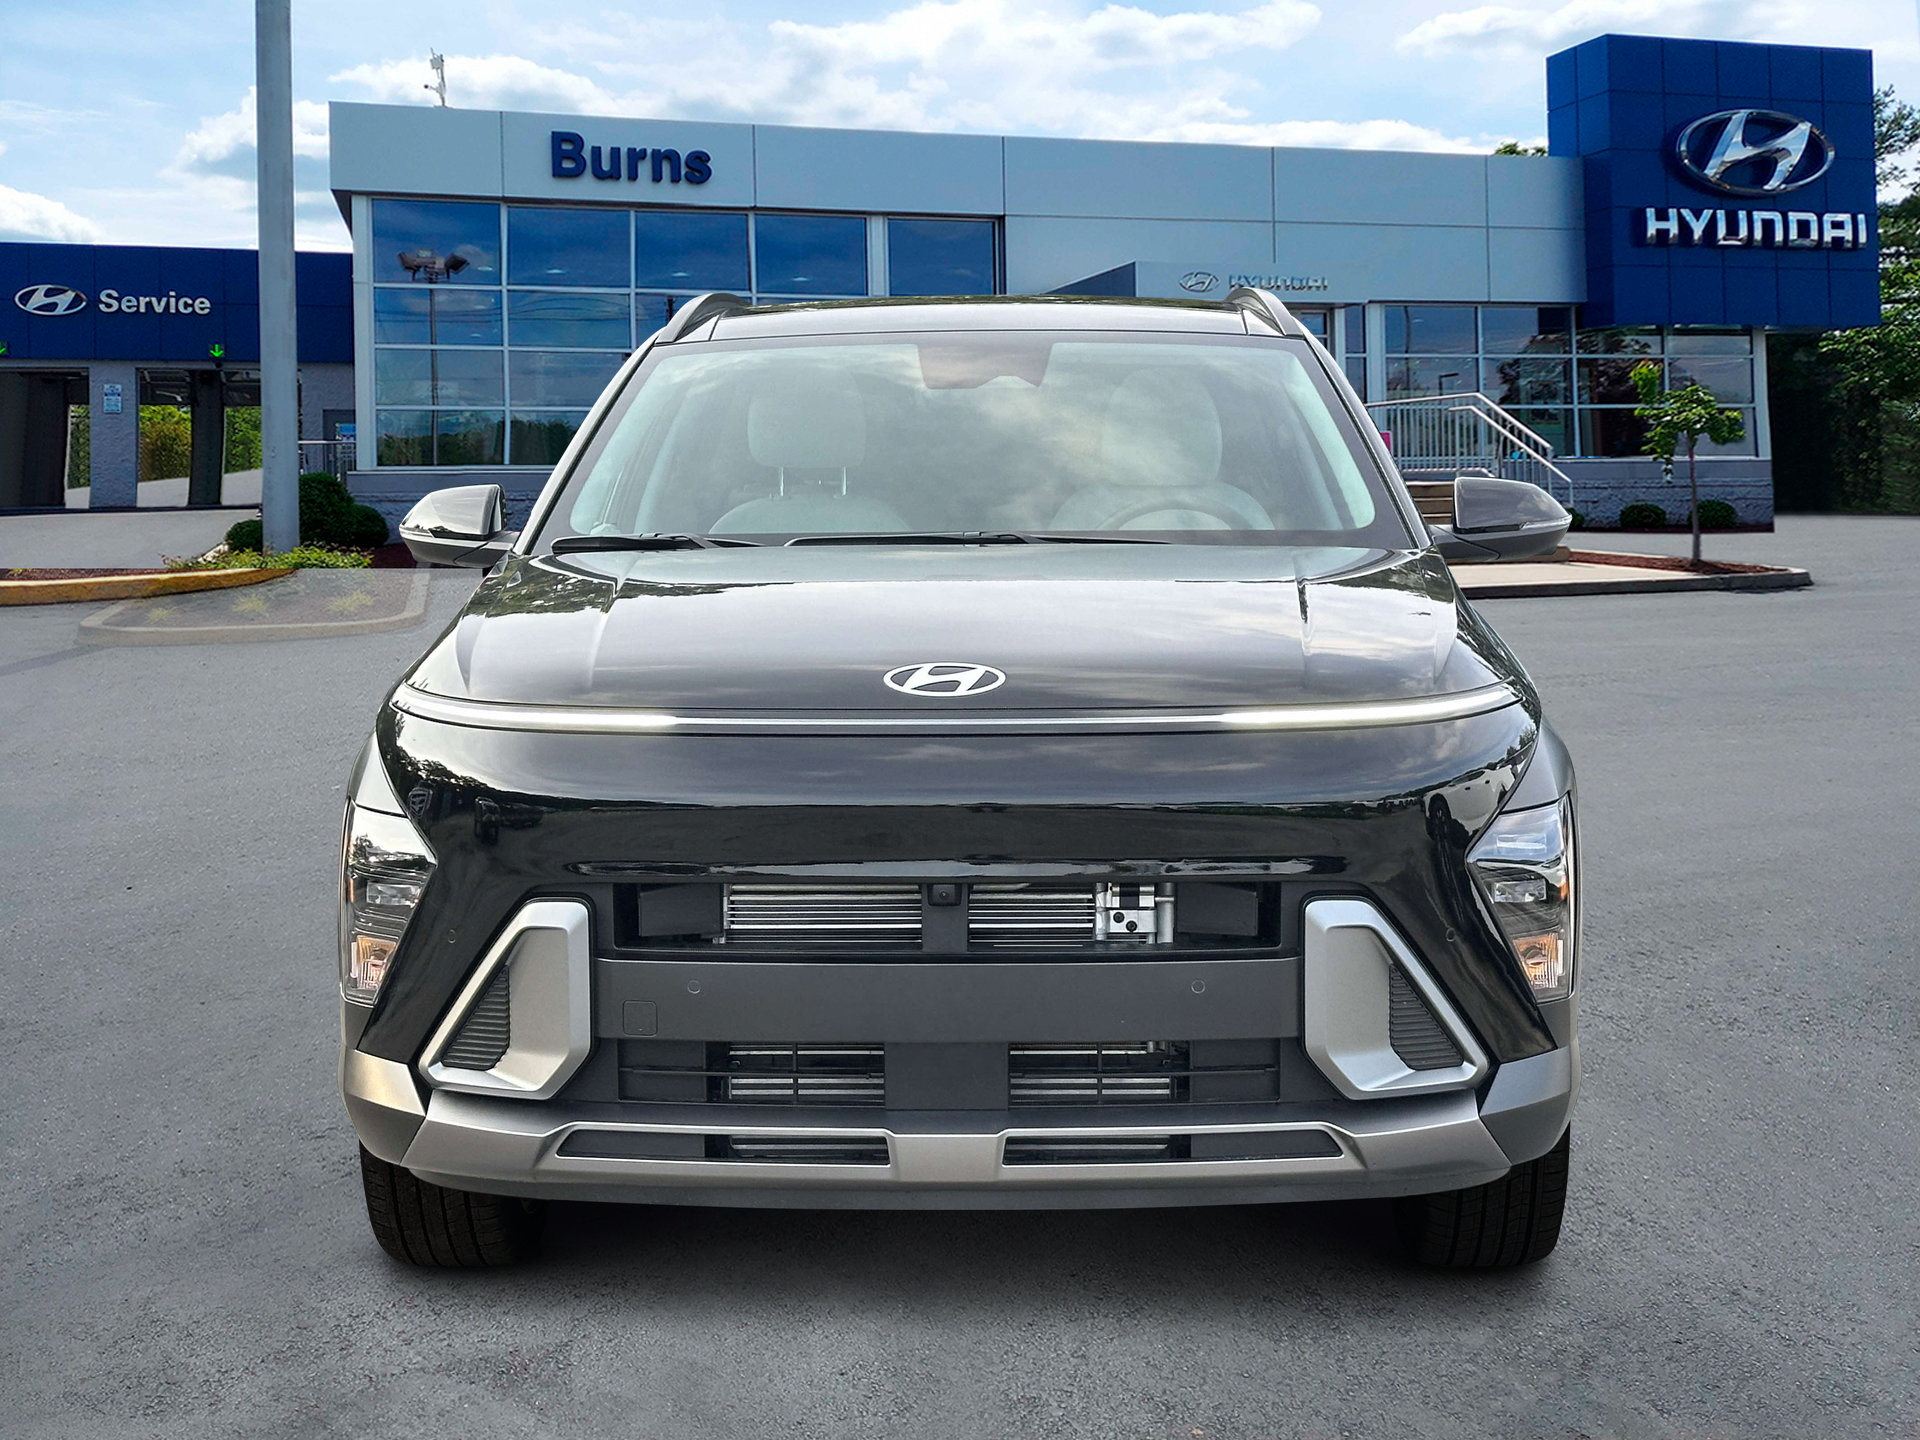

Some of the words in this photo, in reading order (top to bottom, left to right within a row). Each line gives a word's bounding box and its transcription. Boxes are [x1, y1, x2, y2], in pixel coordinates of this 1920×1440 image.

[551, 131, 712, 184] Burns
[1646, 207, 1867, 248] HYUNDAI
[1228, 274, 1328, 291] HYUNDAI
[98, 289, 211, 315] Service
